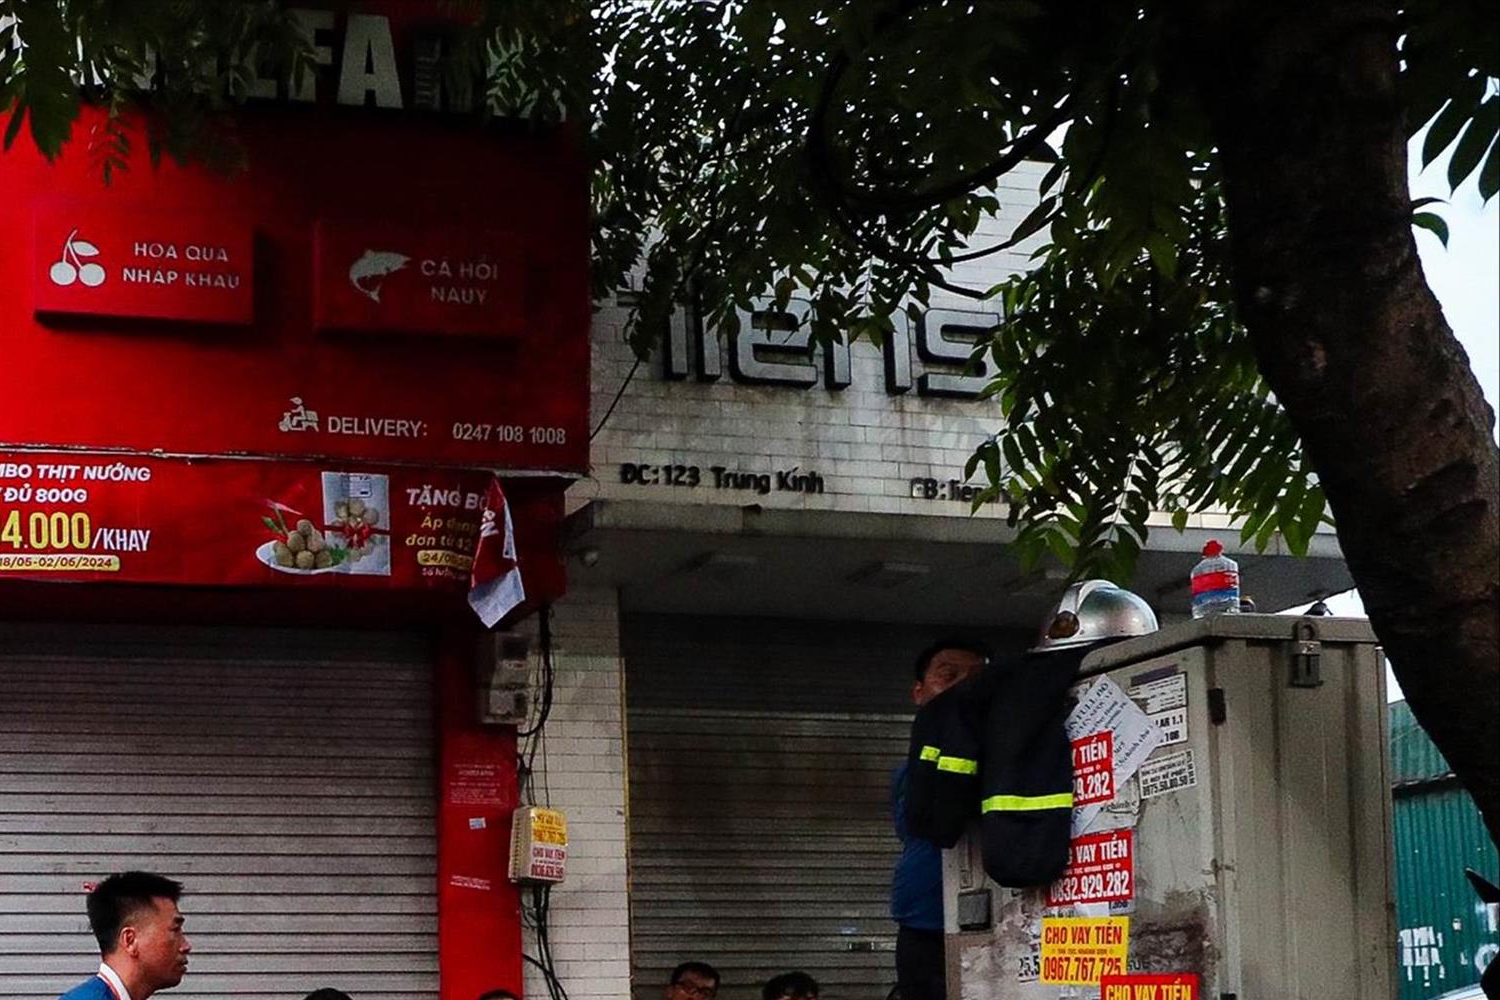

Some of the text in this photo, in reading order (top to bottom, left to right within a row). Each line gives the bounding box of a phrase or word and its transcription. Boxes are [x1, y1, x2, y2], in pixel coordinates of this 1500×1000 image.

[134, 241, 178, 259] HOA
[327, 416, 566, 444] DELIVERY: 0247 108 1008
[37, 464, 81, 483] THỊT
[83, 463, 152, 481] NƯỚNG
[710, 466, 771, 495] Trung
[776, 467, 825, 494] Kính
[3, 483, 32, 502] ĐỦ
[35, 488, 88, 503] 800G
[405, 484, 462, 511] TẶNG
[1075, 843, 1097, 864] VAY
[1044, 926, 1068, 945] CHO
[1071, 926, 1091, 945] VAY
